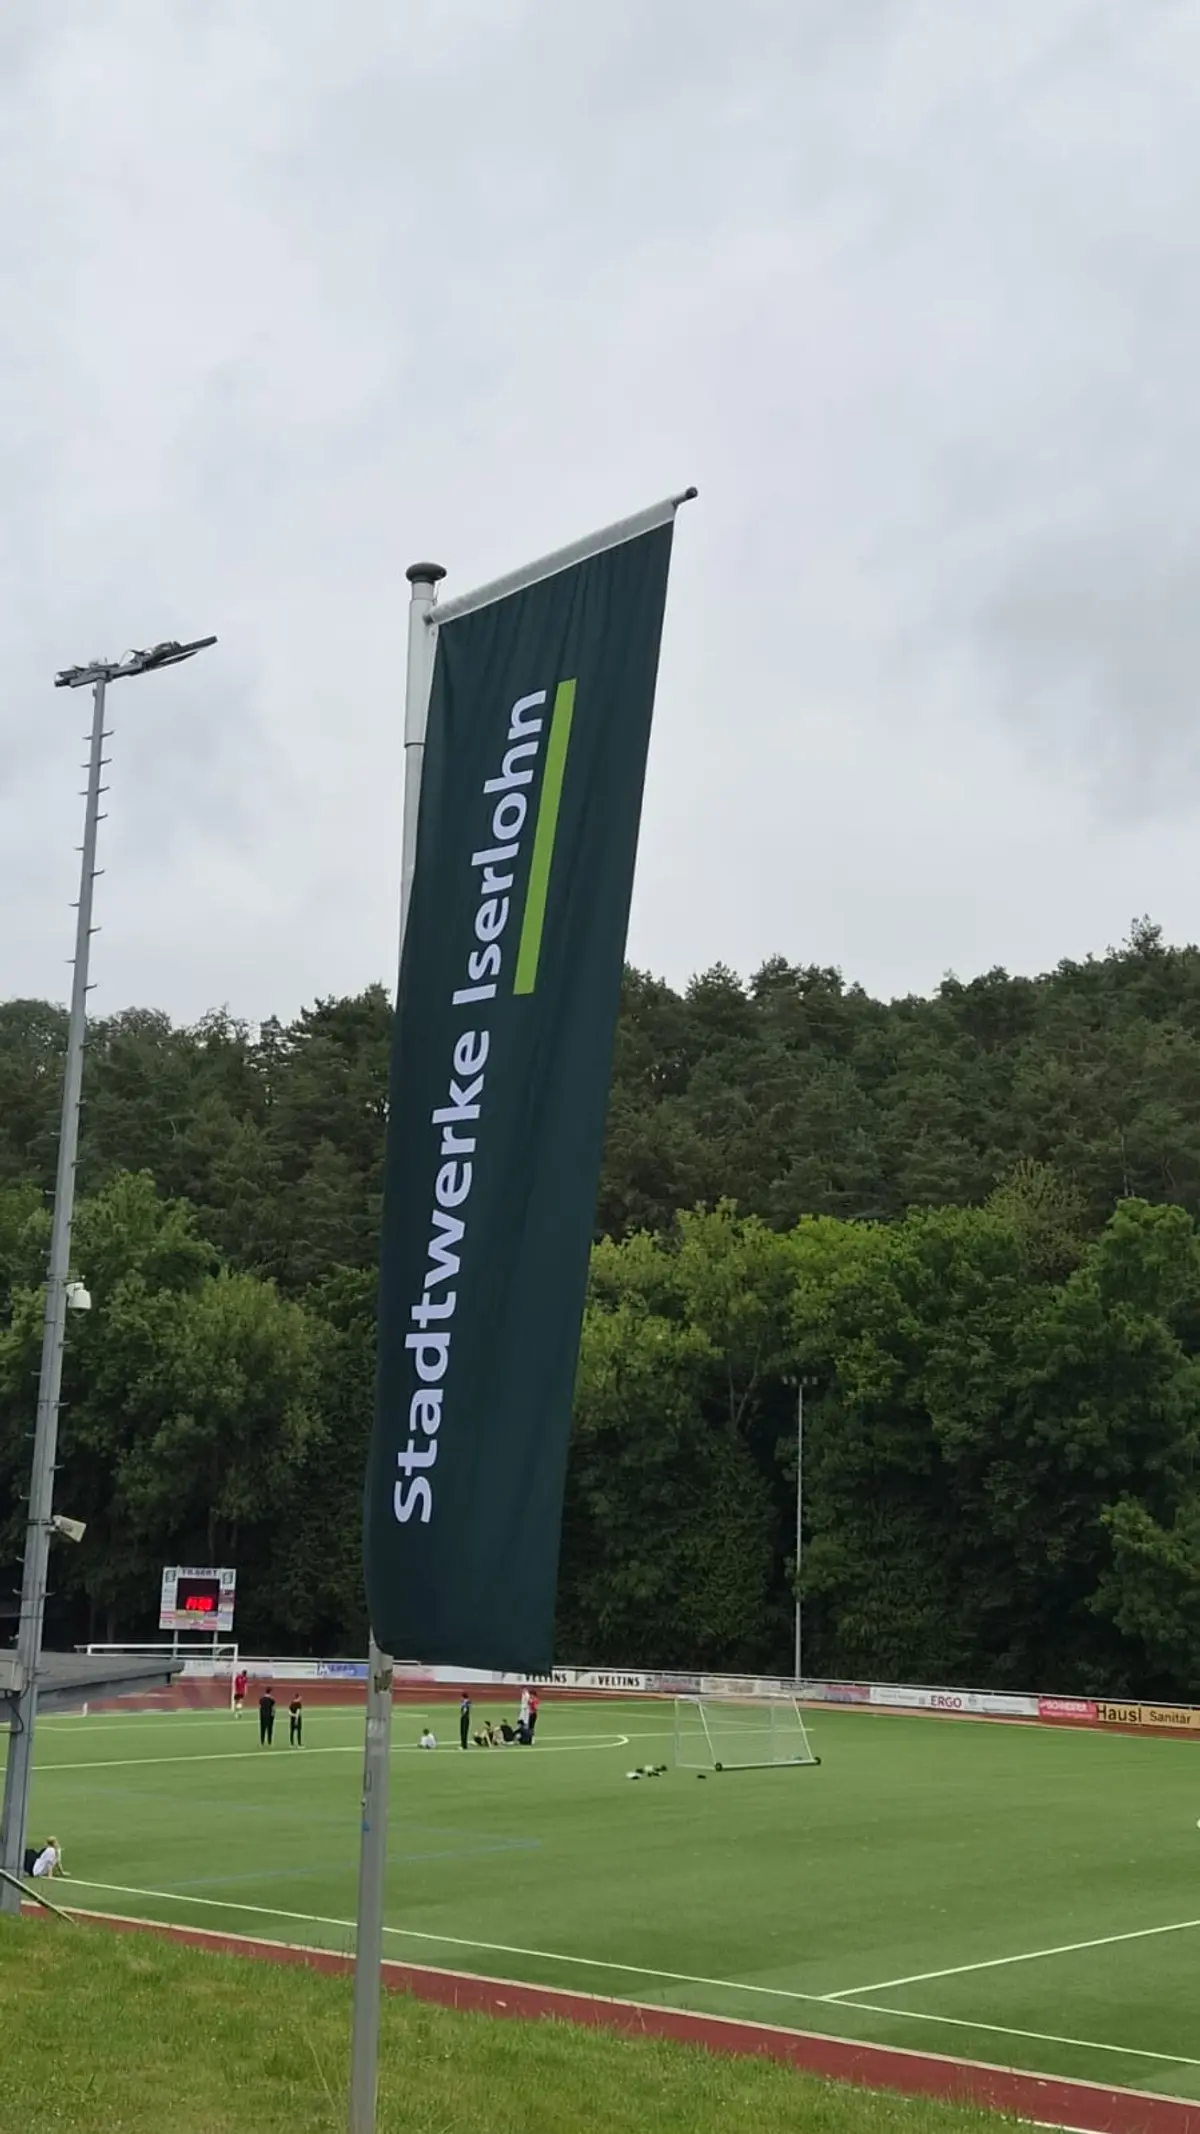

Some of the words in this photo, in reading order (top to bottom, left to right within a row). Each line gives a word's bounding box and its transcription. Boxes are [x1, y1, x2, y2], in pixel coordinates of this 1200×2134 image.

[394, 1030, 490, 1524] Stadtwerke
[452, 689, 547, 1006] Iserlohn
[597, 1674, 640, 1687] VELTINS
[930, 1694, 963, 1708] ERGO
[1149, 1709, 1192, 1724] Sanitär
